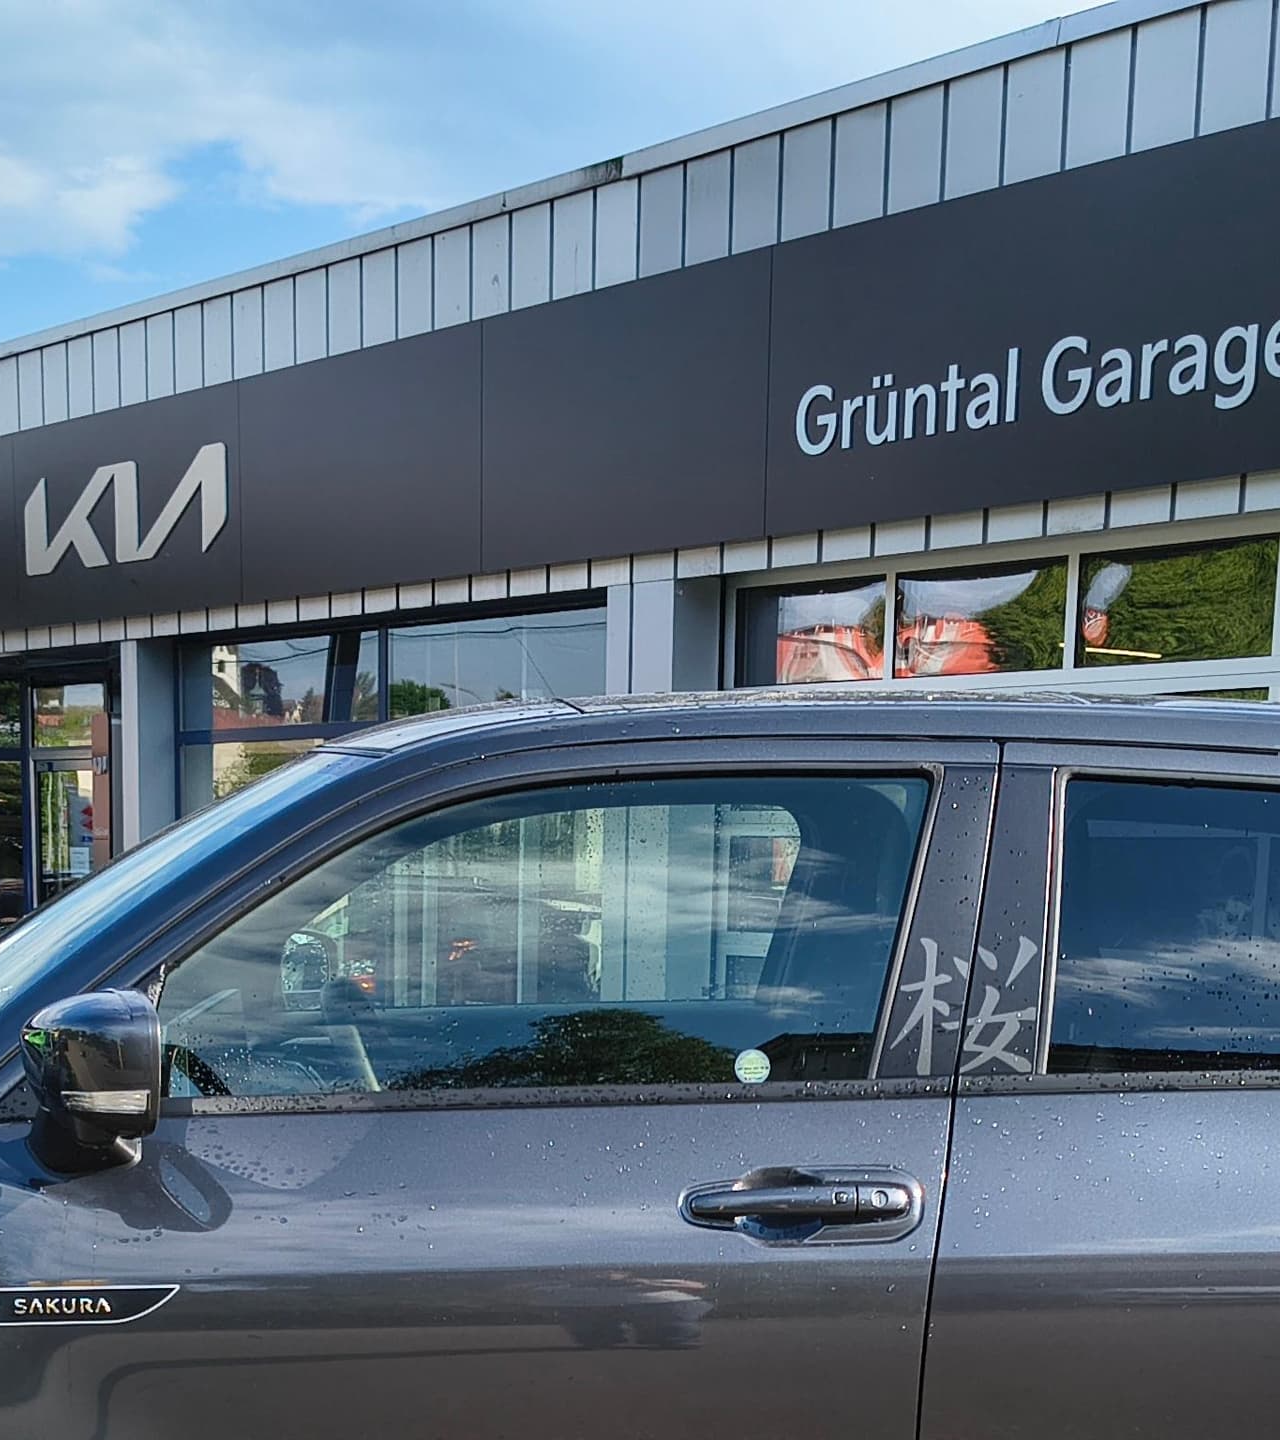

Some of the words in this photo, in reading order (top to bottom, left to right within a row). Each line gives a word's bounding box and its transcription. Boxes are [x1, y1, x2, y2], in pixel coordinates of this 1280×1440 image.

[795, 346, 1019, 456] Grüntal
[24, 441, 227, 577] KIA
[890, 935, 1039, 1076] 桜
[13, 1297, 112, 1315] SAKURA
